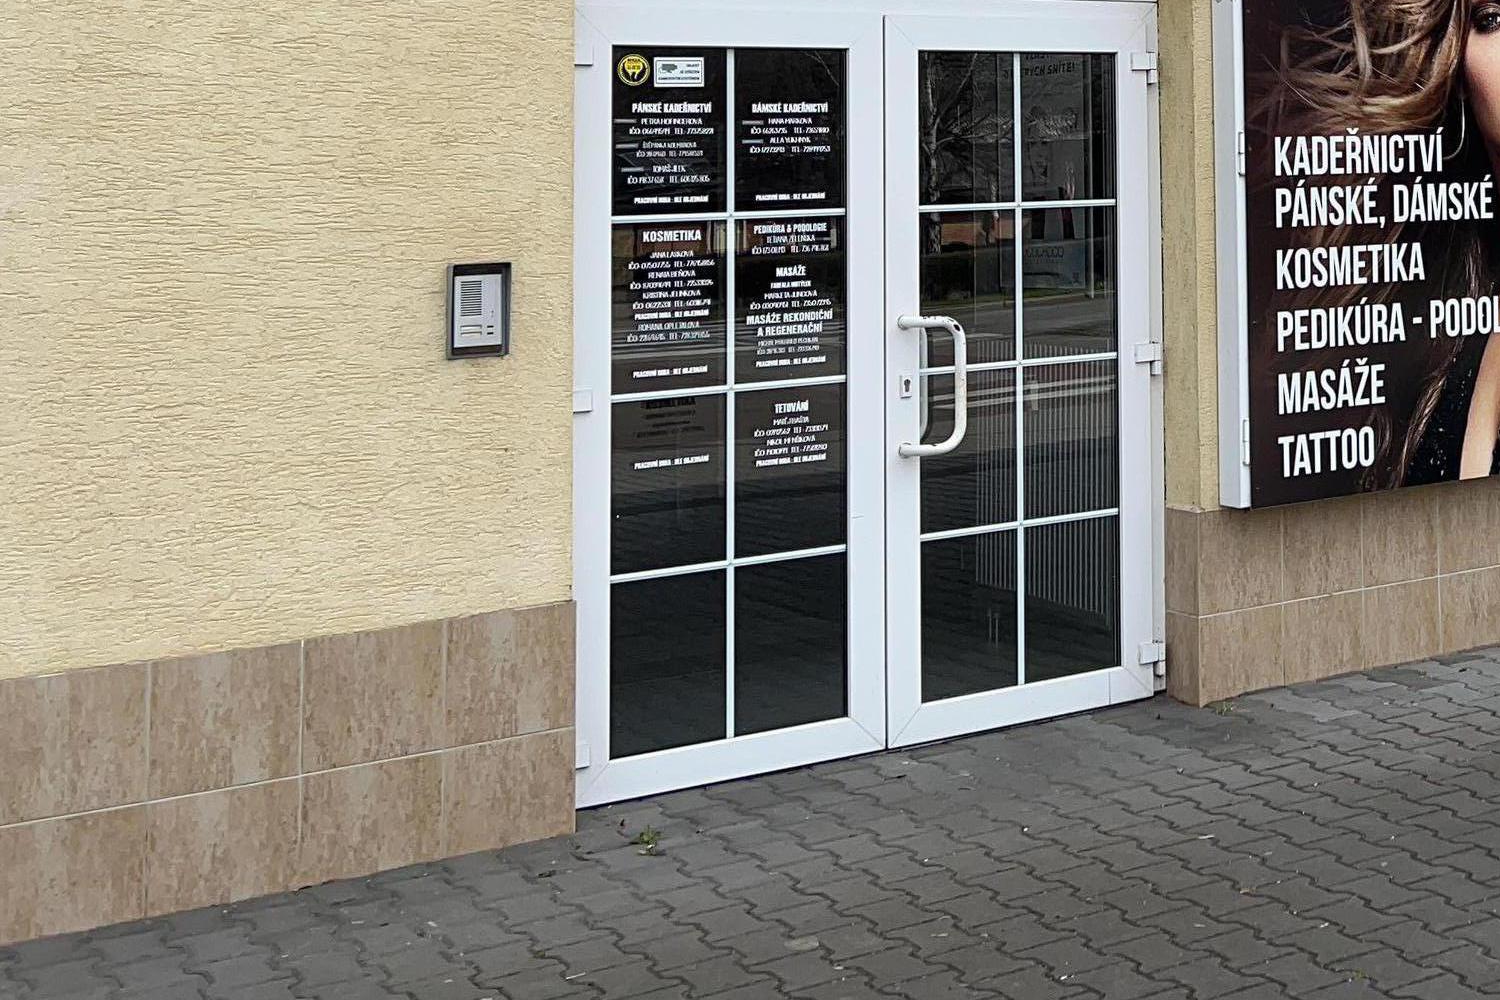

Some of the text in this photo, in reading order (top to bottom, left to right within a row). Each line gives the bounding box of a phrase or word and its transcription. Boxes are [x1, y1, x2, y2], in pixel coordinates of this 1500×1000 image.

[1274, 127, 1445, 177] KADEŘNICTVÍ
[1275, 174, 1494, 228] PÁNSKÉ, DÁMSKÉ
[642, 229, 702, 243] KOSMETIKA
[775, 265, 807, 277] MASÁŽE
[1275, 242, 1426, 291] KOSMETIKA
[746, 308, 833, 326] MASÁŽE REKONDIČNÍ
[756, 321, 823, 337] A REGENERAČNÍ
[1276, 297, 1407, 352] PEDIKÚRA
[1277, 358, 1386, 415] MASÁŽE
[1277, 426, 1376, 478] TATTOO
